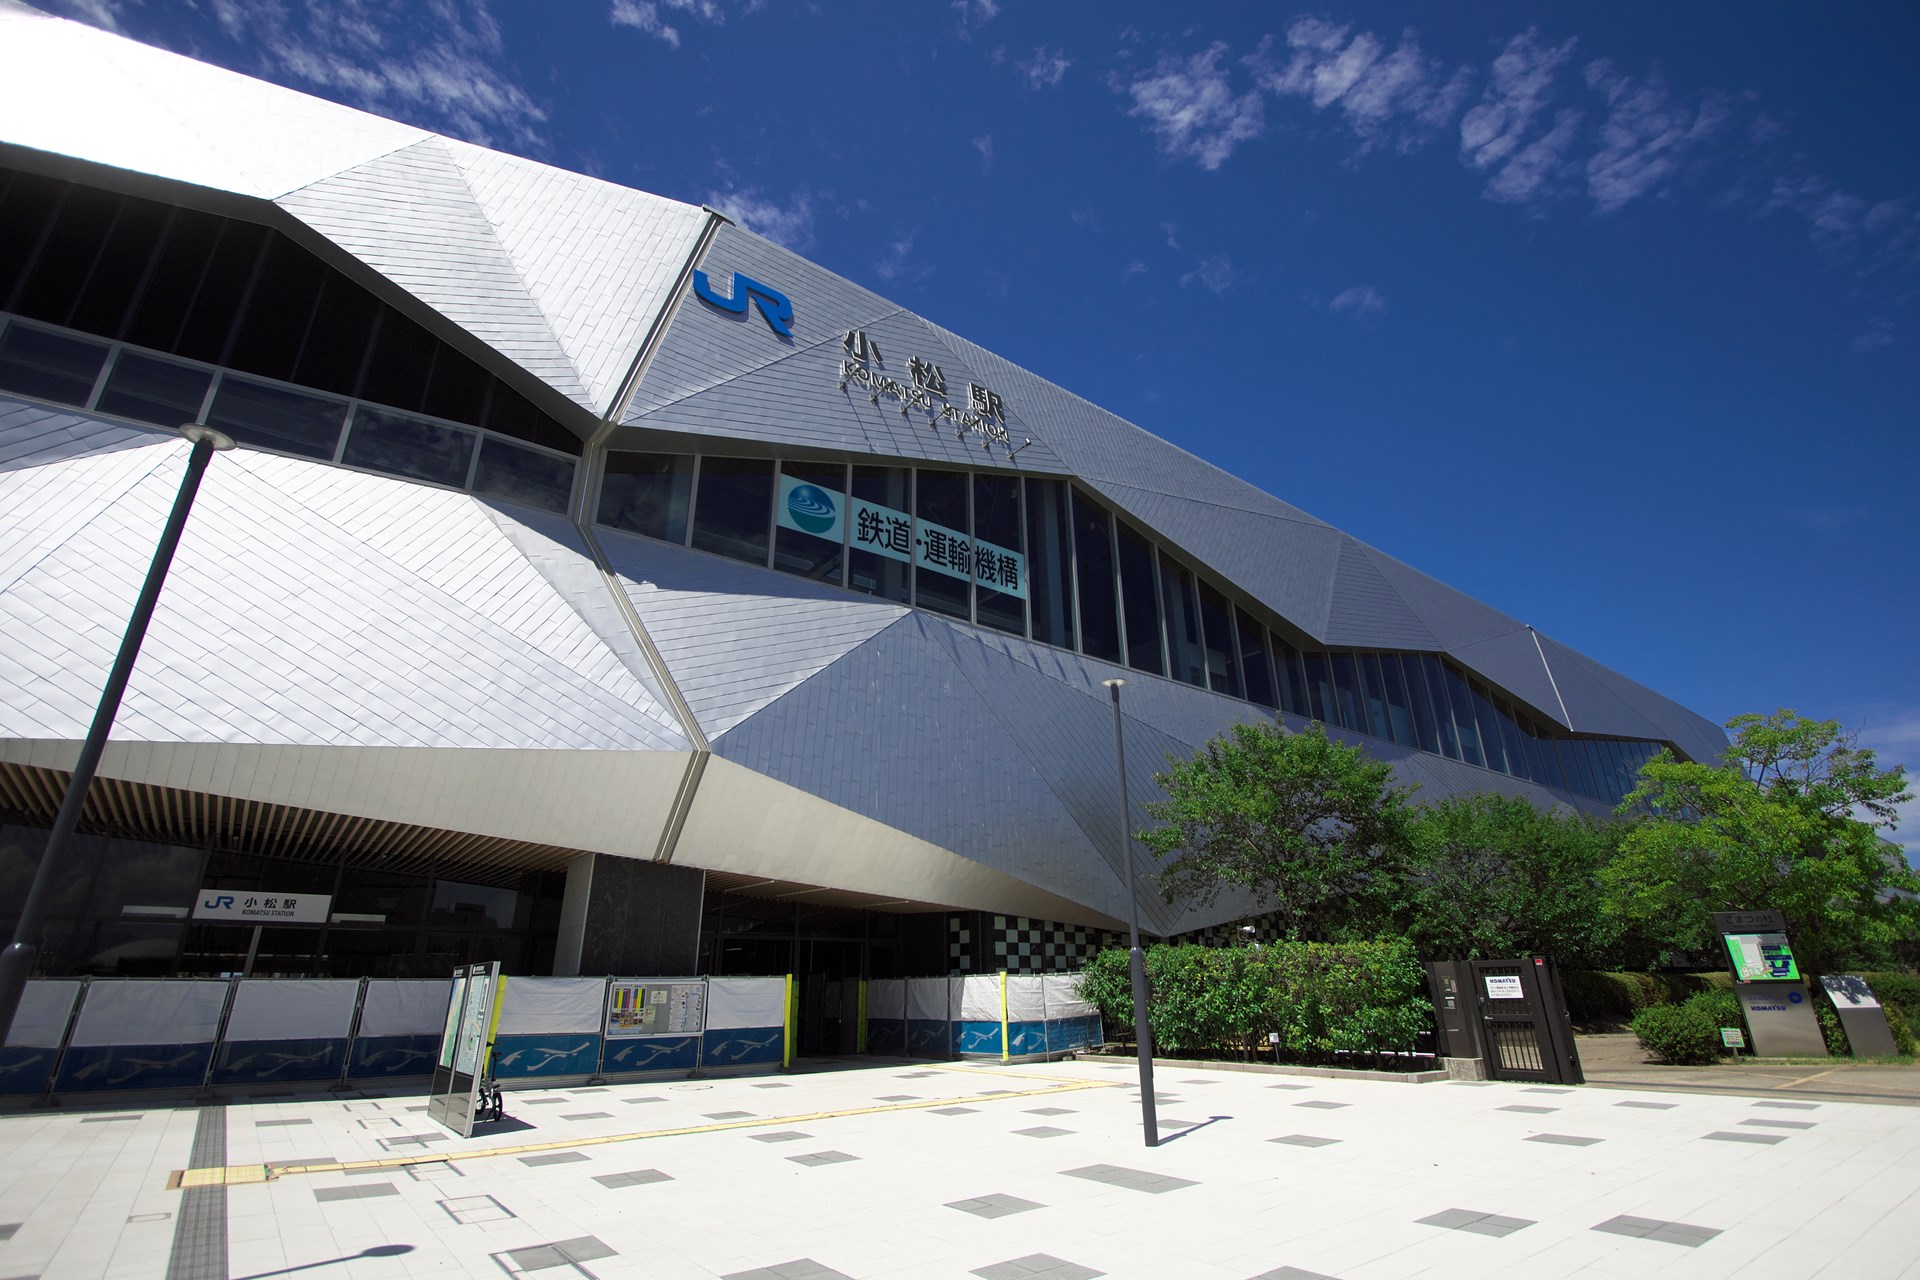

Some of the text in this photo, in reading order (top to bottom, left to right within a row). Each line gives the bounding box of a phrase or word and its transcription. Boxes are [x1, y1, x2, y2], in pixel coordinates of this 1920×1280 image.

[693, 269, 794, 338] JR
[841, 360, 1010, 444] KOMATSU STATION
[842, 330, 1006, 424] 小松駅
[857, 507, 1019, 590] 鉄道・運輸機構
[204, 896, 235, 910] JR
[242, 909, 270, 917] KOMATSU
[244, 897, 297, 910] 小松駅
